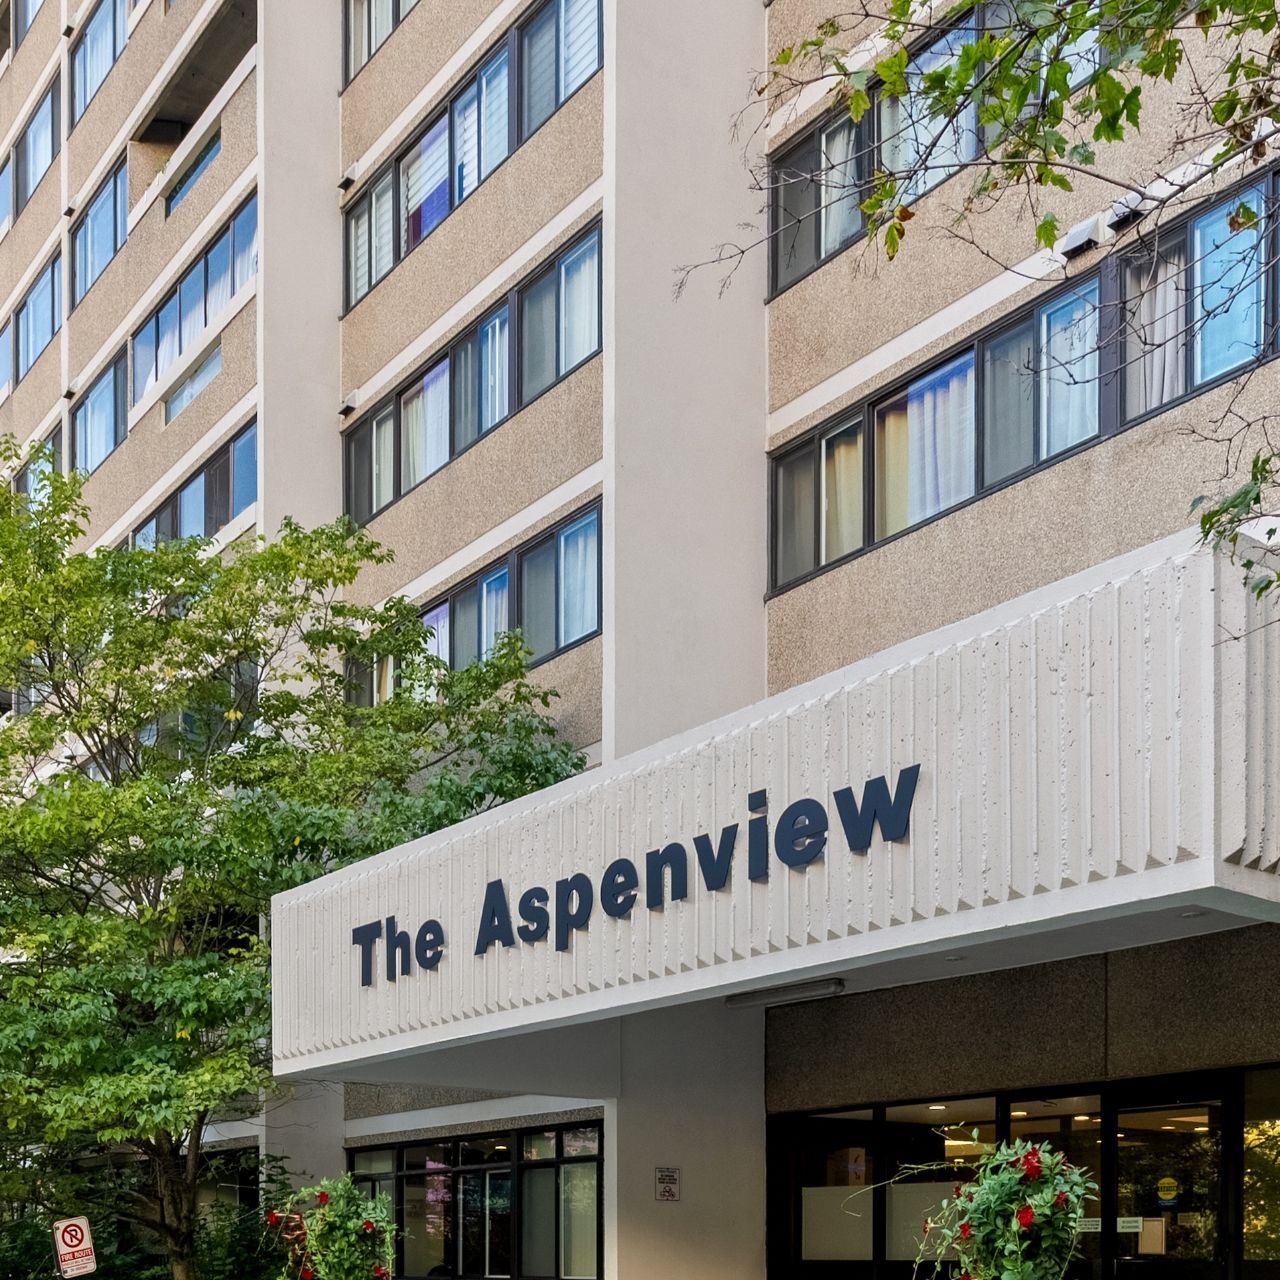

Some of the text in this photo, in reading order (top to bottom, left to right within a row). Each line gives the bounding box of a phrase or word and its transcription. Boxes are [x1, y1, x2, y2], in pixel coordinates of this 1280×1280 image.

[351, 763, 921, 987] The Aspenview
[74, 1248, 92, 1259] ROUTE
